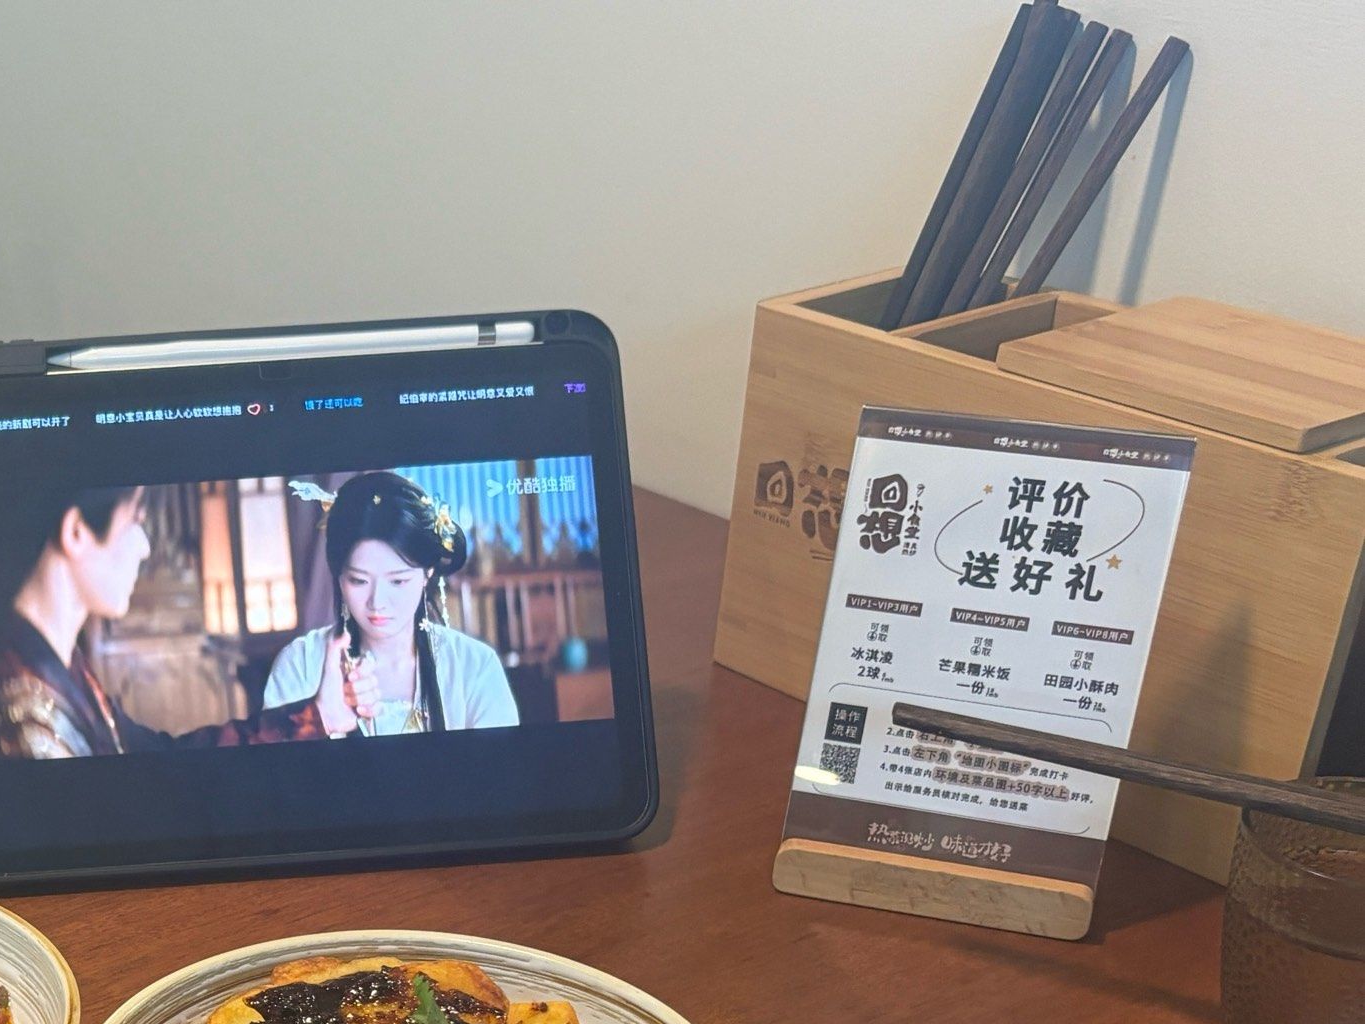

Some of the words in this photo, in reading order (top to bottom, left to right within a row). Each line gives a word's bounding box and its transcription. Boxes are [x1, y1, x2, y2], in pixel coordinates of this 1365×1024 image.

[506, 475, 576, 495] 优酷独播
[1008, 476, 1091, 518] 评价
[999, 516, 1083, 558] 收藏
[958, 550, 1103, 602] 送好礼
[857, 665, 881, 680] 2球
[938, 659, 1011, 681] 芒果糯米饭
[956, 681, 985, 695] 一份
[1044, 674, 1119, 697] 田园小酥肉
[1062, 696, 1093, 710] 一份
